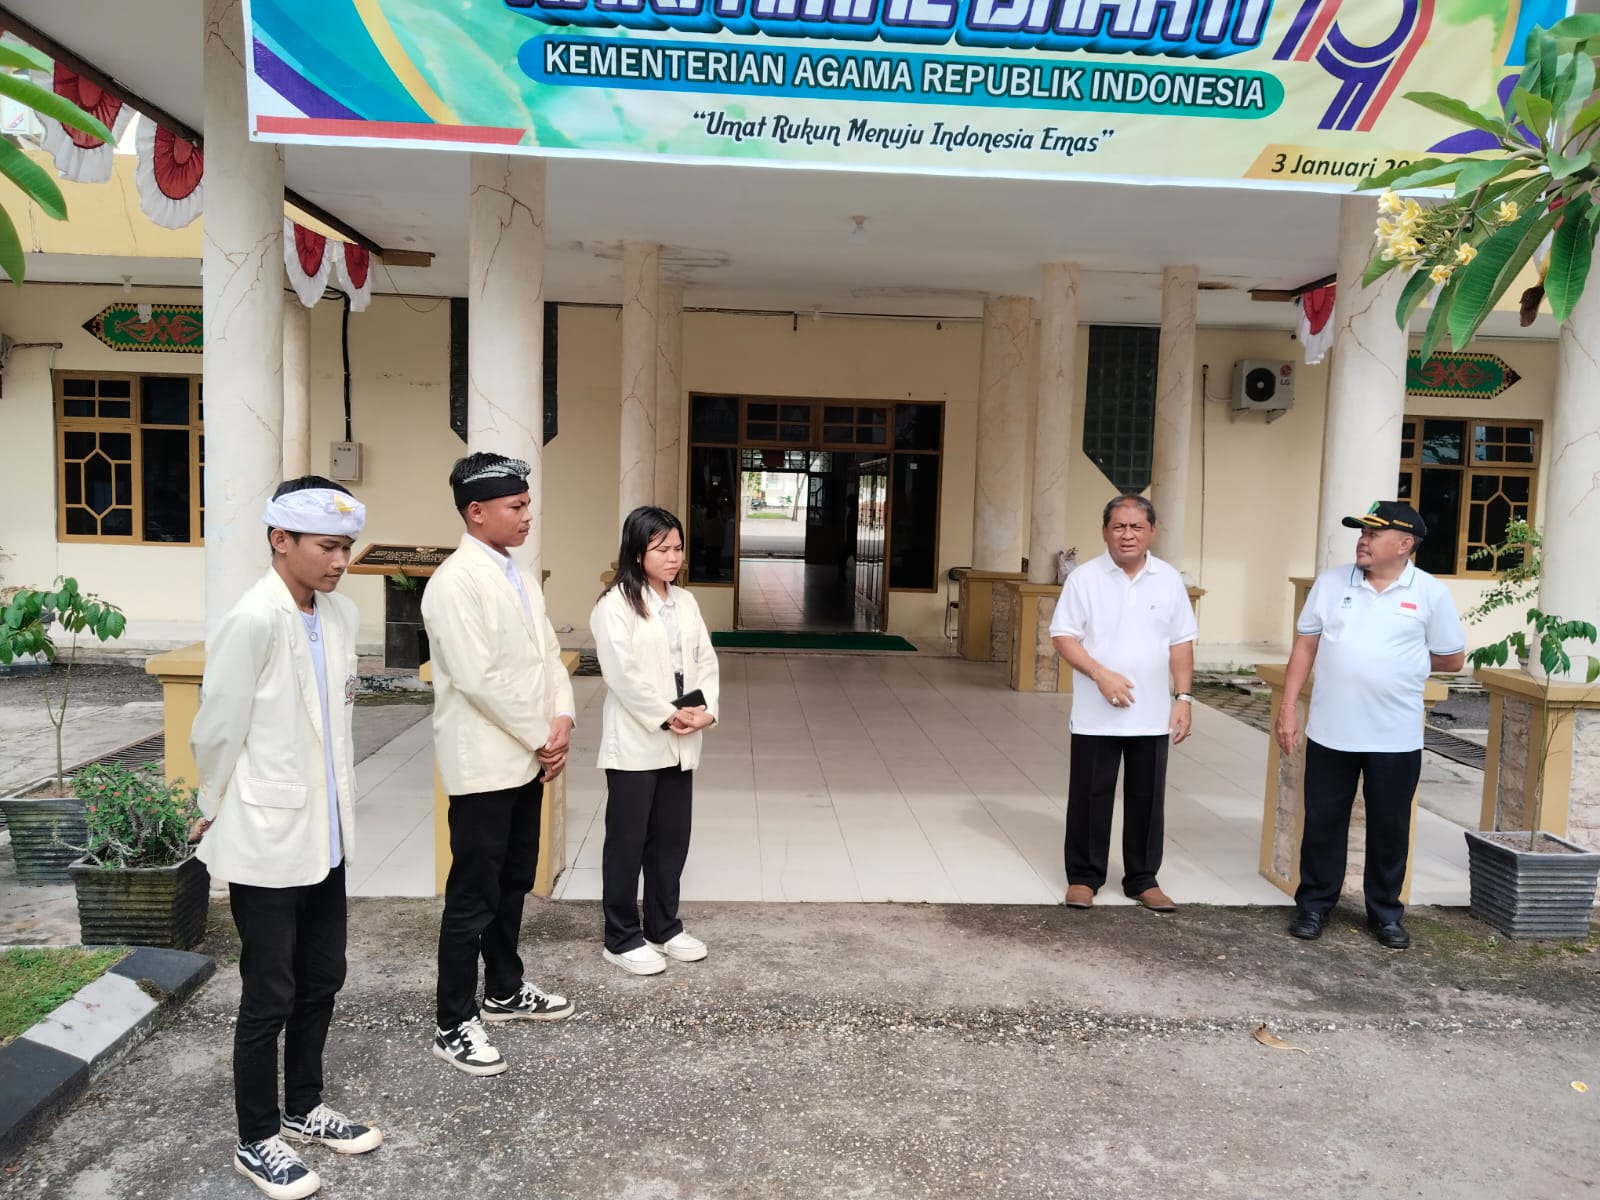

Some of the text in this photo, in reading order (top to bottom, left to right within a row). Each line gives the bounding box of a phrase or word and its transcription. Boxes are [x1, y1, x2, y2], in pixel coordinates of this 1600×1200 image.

[545, 43, 1264, 108] KEMENTERIAN AGAMA REPUBLIK INDONESIA
[771, 114, 841, 147] Rukun
[846, 118, 925, 150] Menuju
[930, 122, 1035, 154] Indonesia
[1271, 153, 1287, 173] 3
[1291, 154, 1378, 178] Januari
